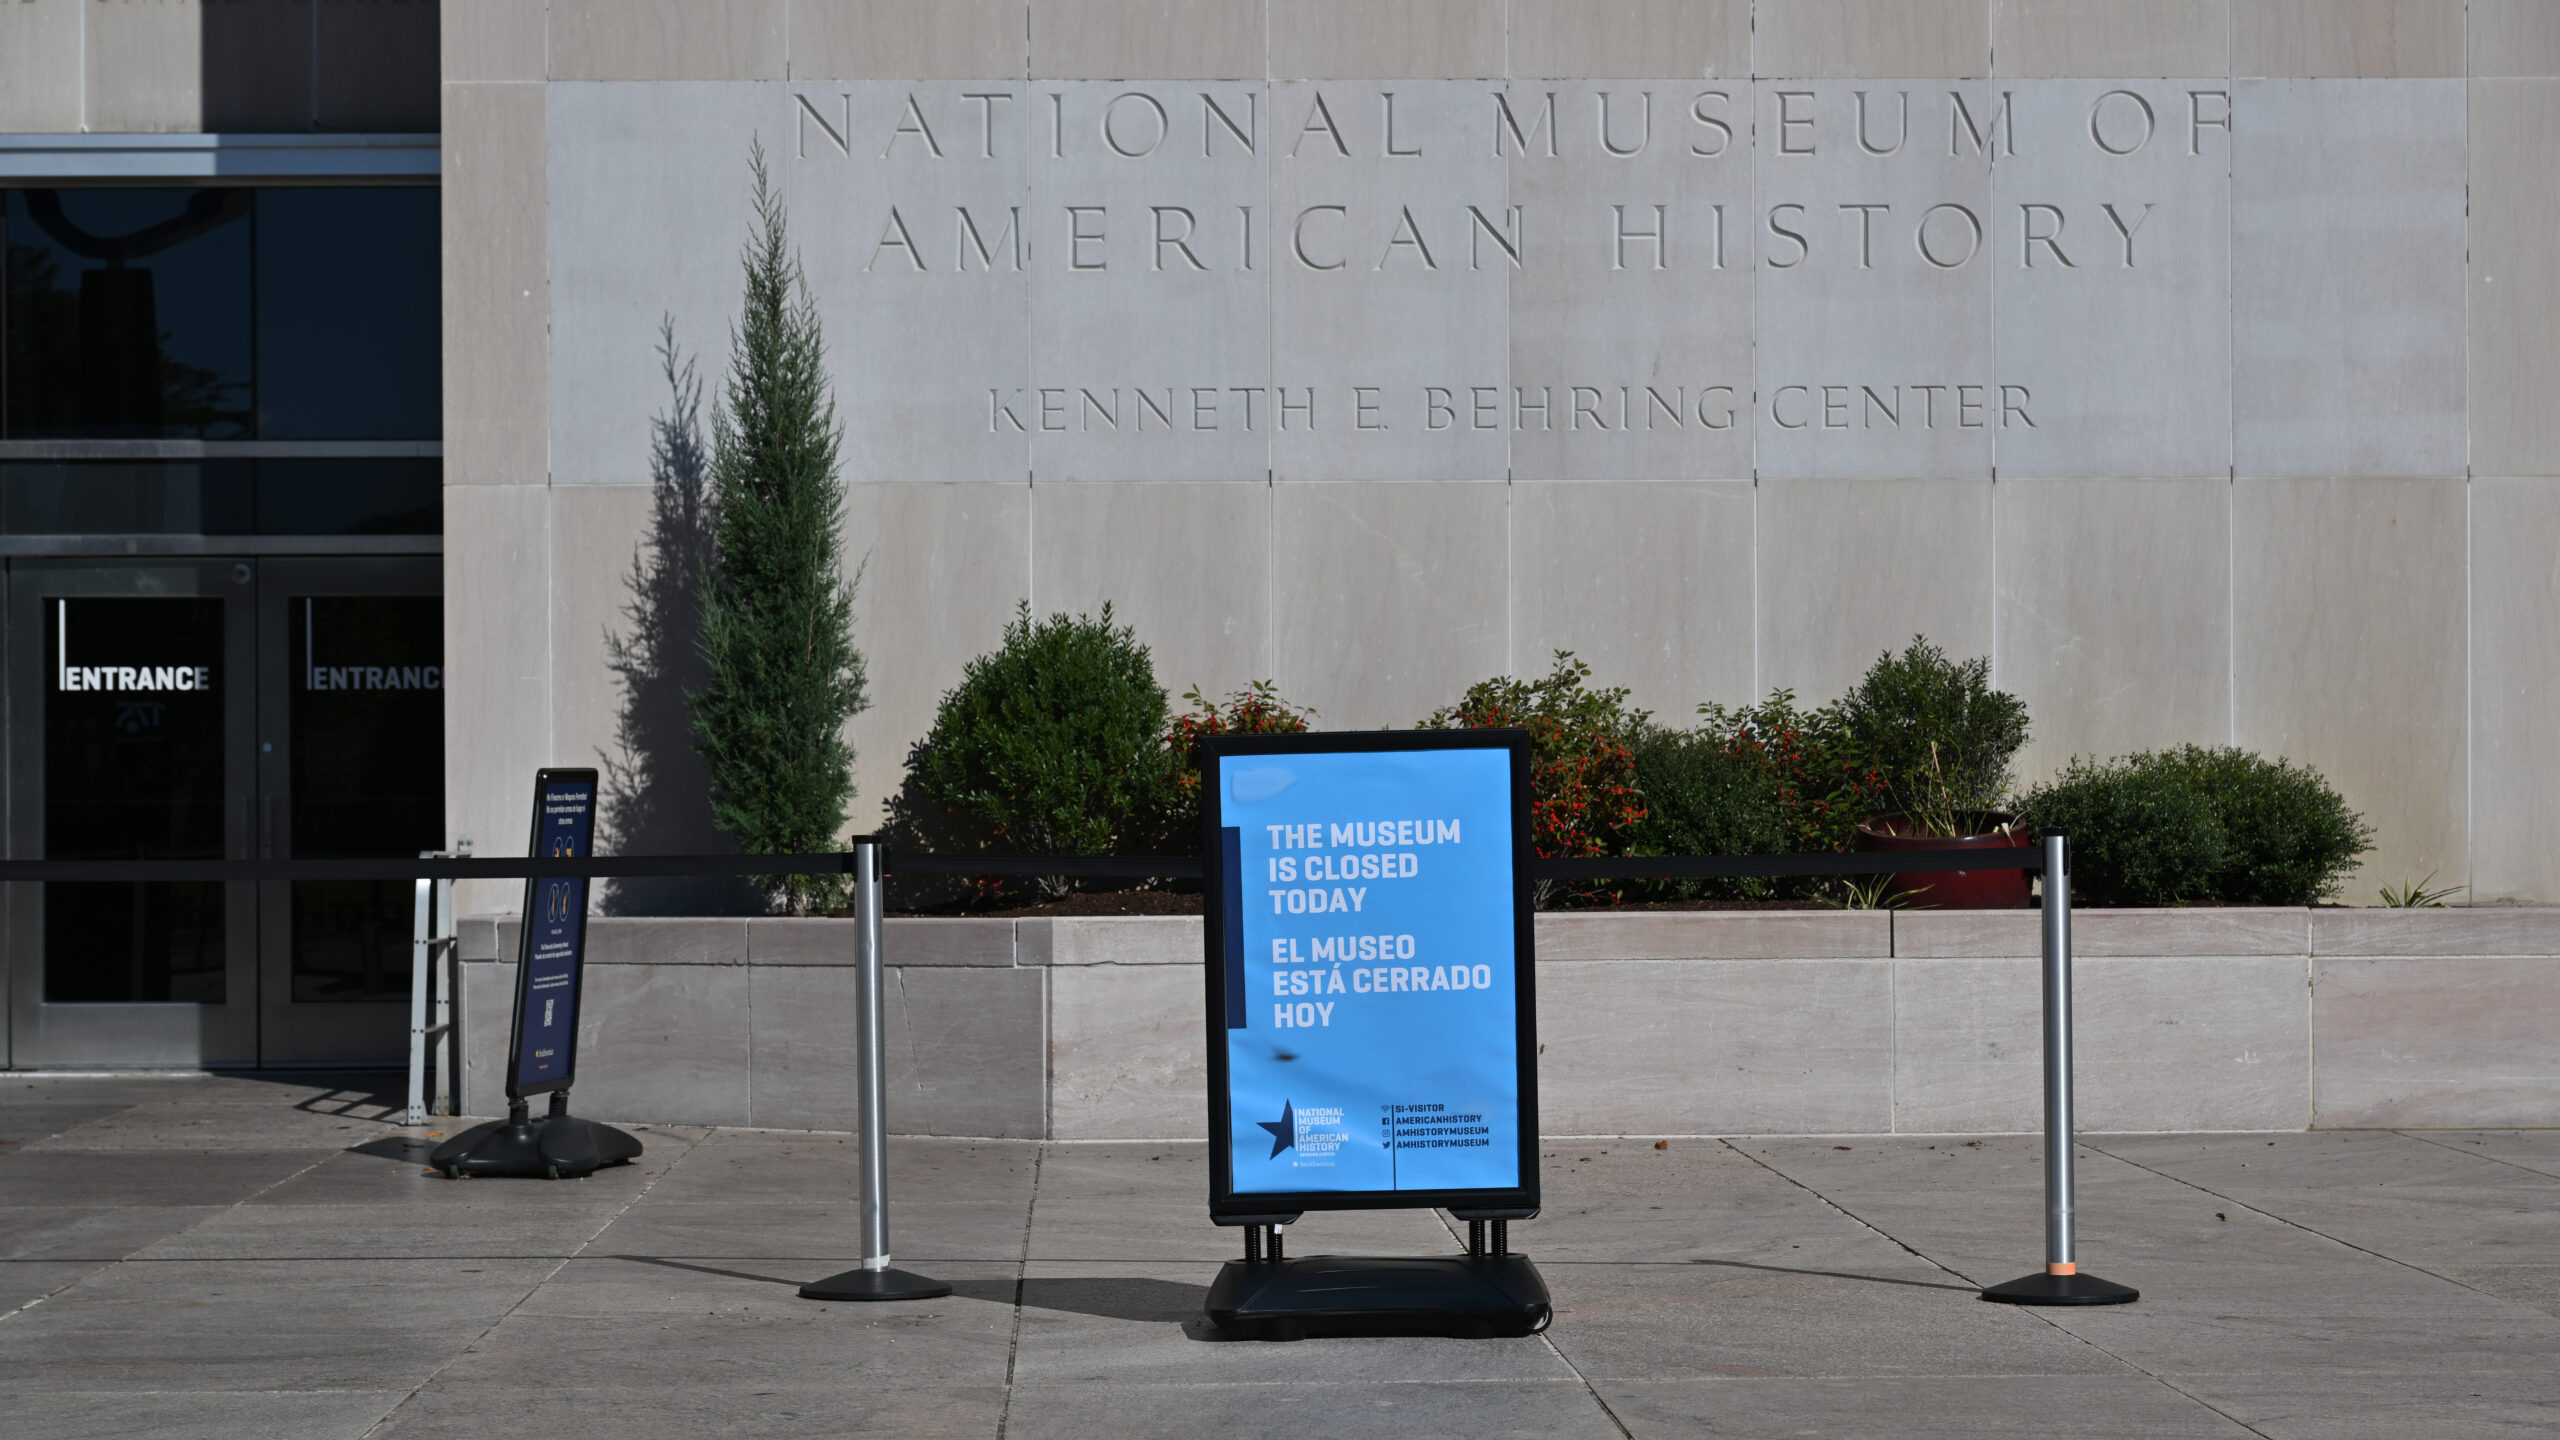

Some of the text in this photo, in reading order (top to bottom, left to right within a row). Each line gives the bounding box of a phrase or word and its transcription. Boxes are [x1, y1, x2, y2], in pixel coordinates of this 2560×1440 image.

[791, 89, 2231, 160] NATIONAL MUSEUM OF
[861, 202, 2157, 273] AMERICAN HISTORY
[988, 384, 2039, 435] KENNETH E. BEHRING CENTER
[66, 666, 210, 691] ENTRANCE
[313, 666, 445, 690] ENTRANC
[1267, 819, 1461, 850] THE MUSEUM
[1269, 853, 1418, 882] IS CLOSED
[1269, 887, 1367, 914] TODAY
[1273, 934, 1416, 963] EL MUSEO
[1274, 963, 1491, 995] ESTÁ CERRADO
[1275, 1002, 1334, 1028] HOY
[1298, 1107, 1345, 1117] NATIONAL
[1395, 1103, 1445, 1113] SI-VISITOR
[1396, 1115, 1482, 1125] AMERICANHISTORY
[1298, 1116, 1341, 1126] MUSEUM
[1299, 1125, 1312, 1135] OF
[1396, 1127, 1489, 1137] AMHISTORYMUSEUM
[1299, 1133, 1349, 1143] AMERICAN
[1299, 1142, 1341, 1151] HISTORY
[1396, 1138, 1490, 1149] AMHISTORYMUSEUM
